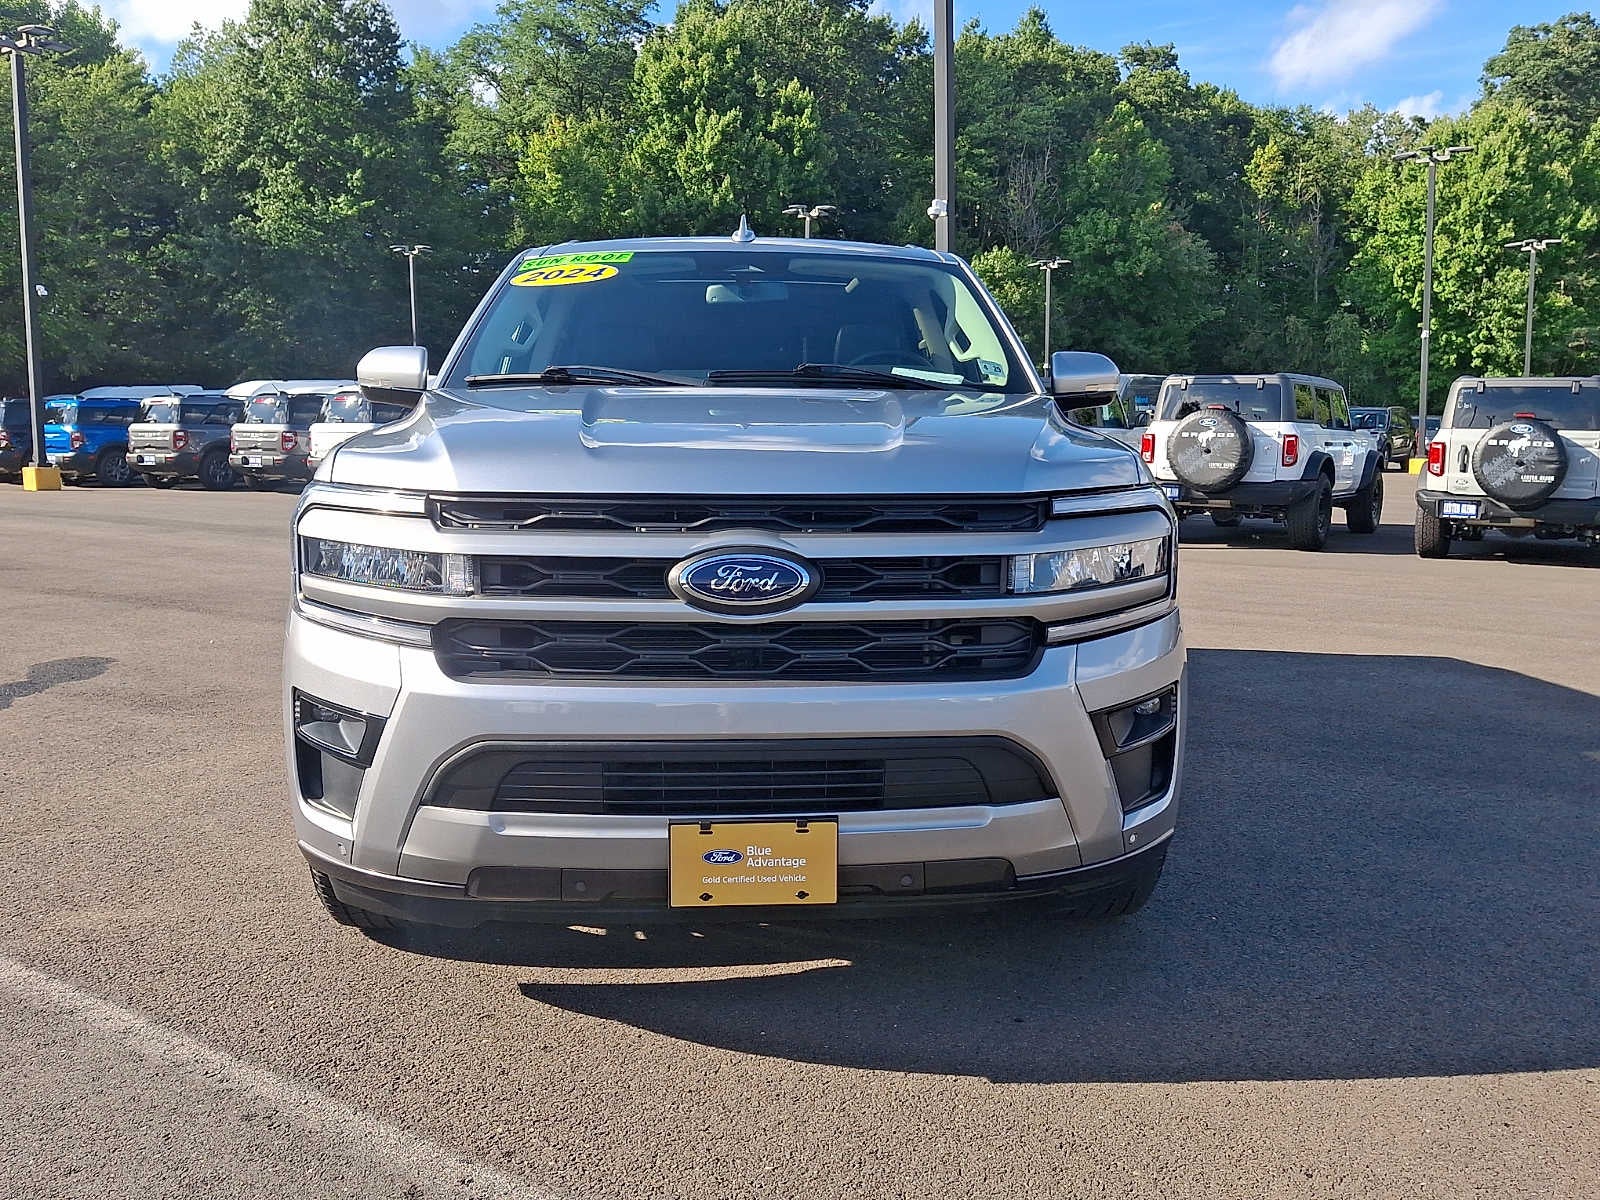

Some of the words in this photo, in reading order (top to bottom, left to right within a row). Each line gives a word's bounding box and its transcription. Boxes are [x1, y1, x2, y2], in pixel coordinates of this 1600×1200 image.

[523, 257, 564, 269] SUN
[570, 253, 630, 263] ROOF
[522, 267, 608, 283] 2024
[710, 564, 780, 593] Ford
[710, 851, 735, 863] Ford
[746, 846, 772, 856] Blue
[746, 857, 807, 868] Advantage
[702, 876, 721, 884] Gold
[722, 875, 755, 883] Certified
[757, 875, 777, 883] Used
[779, 874, 807, 882] Vehicle
